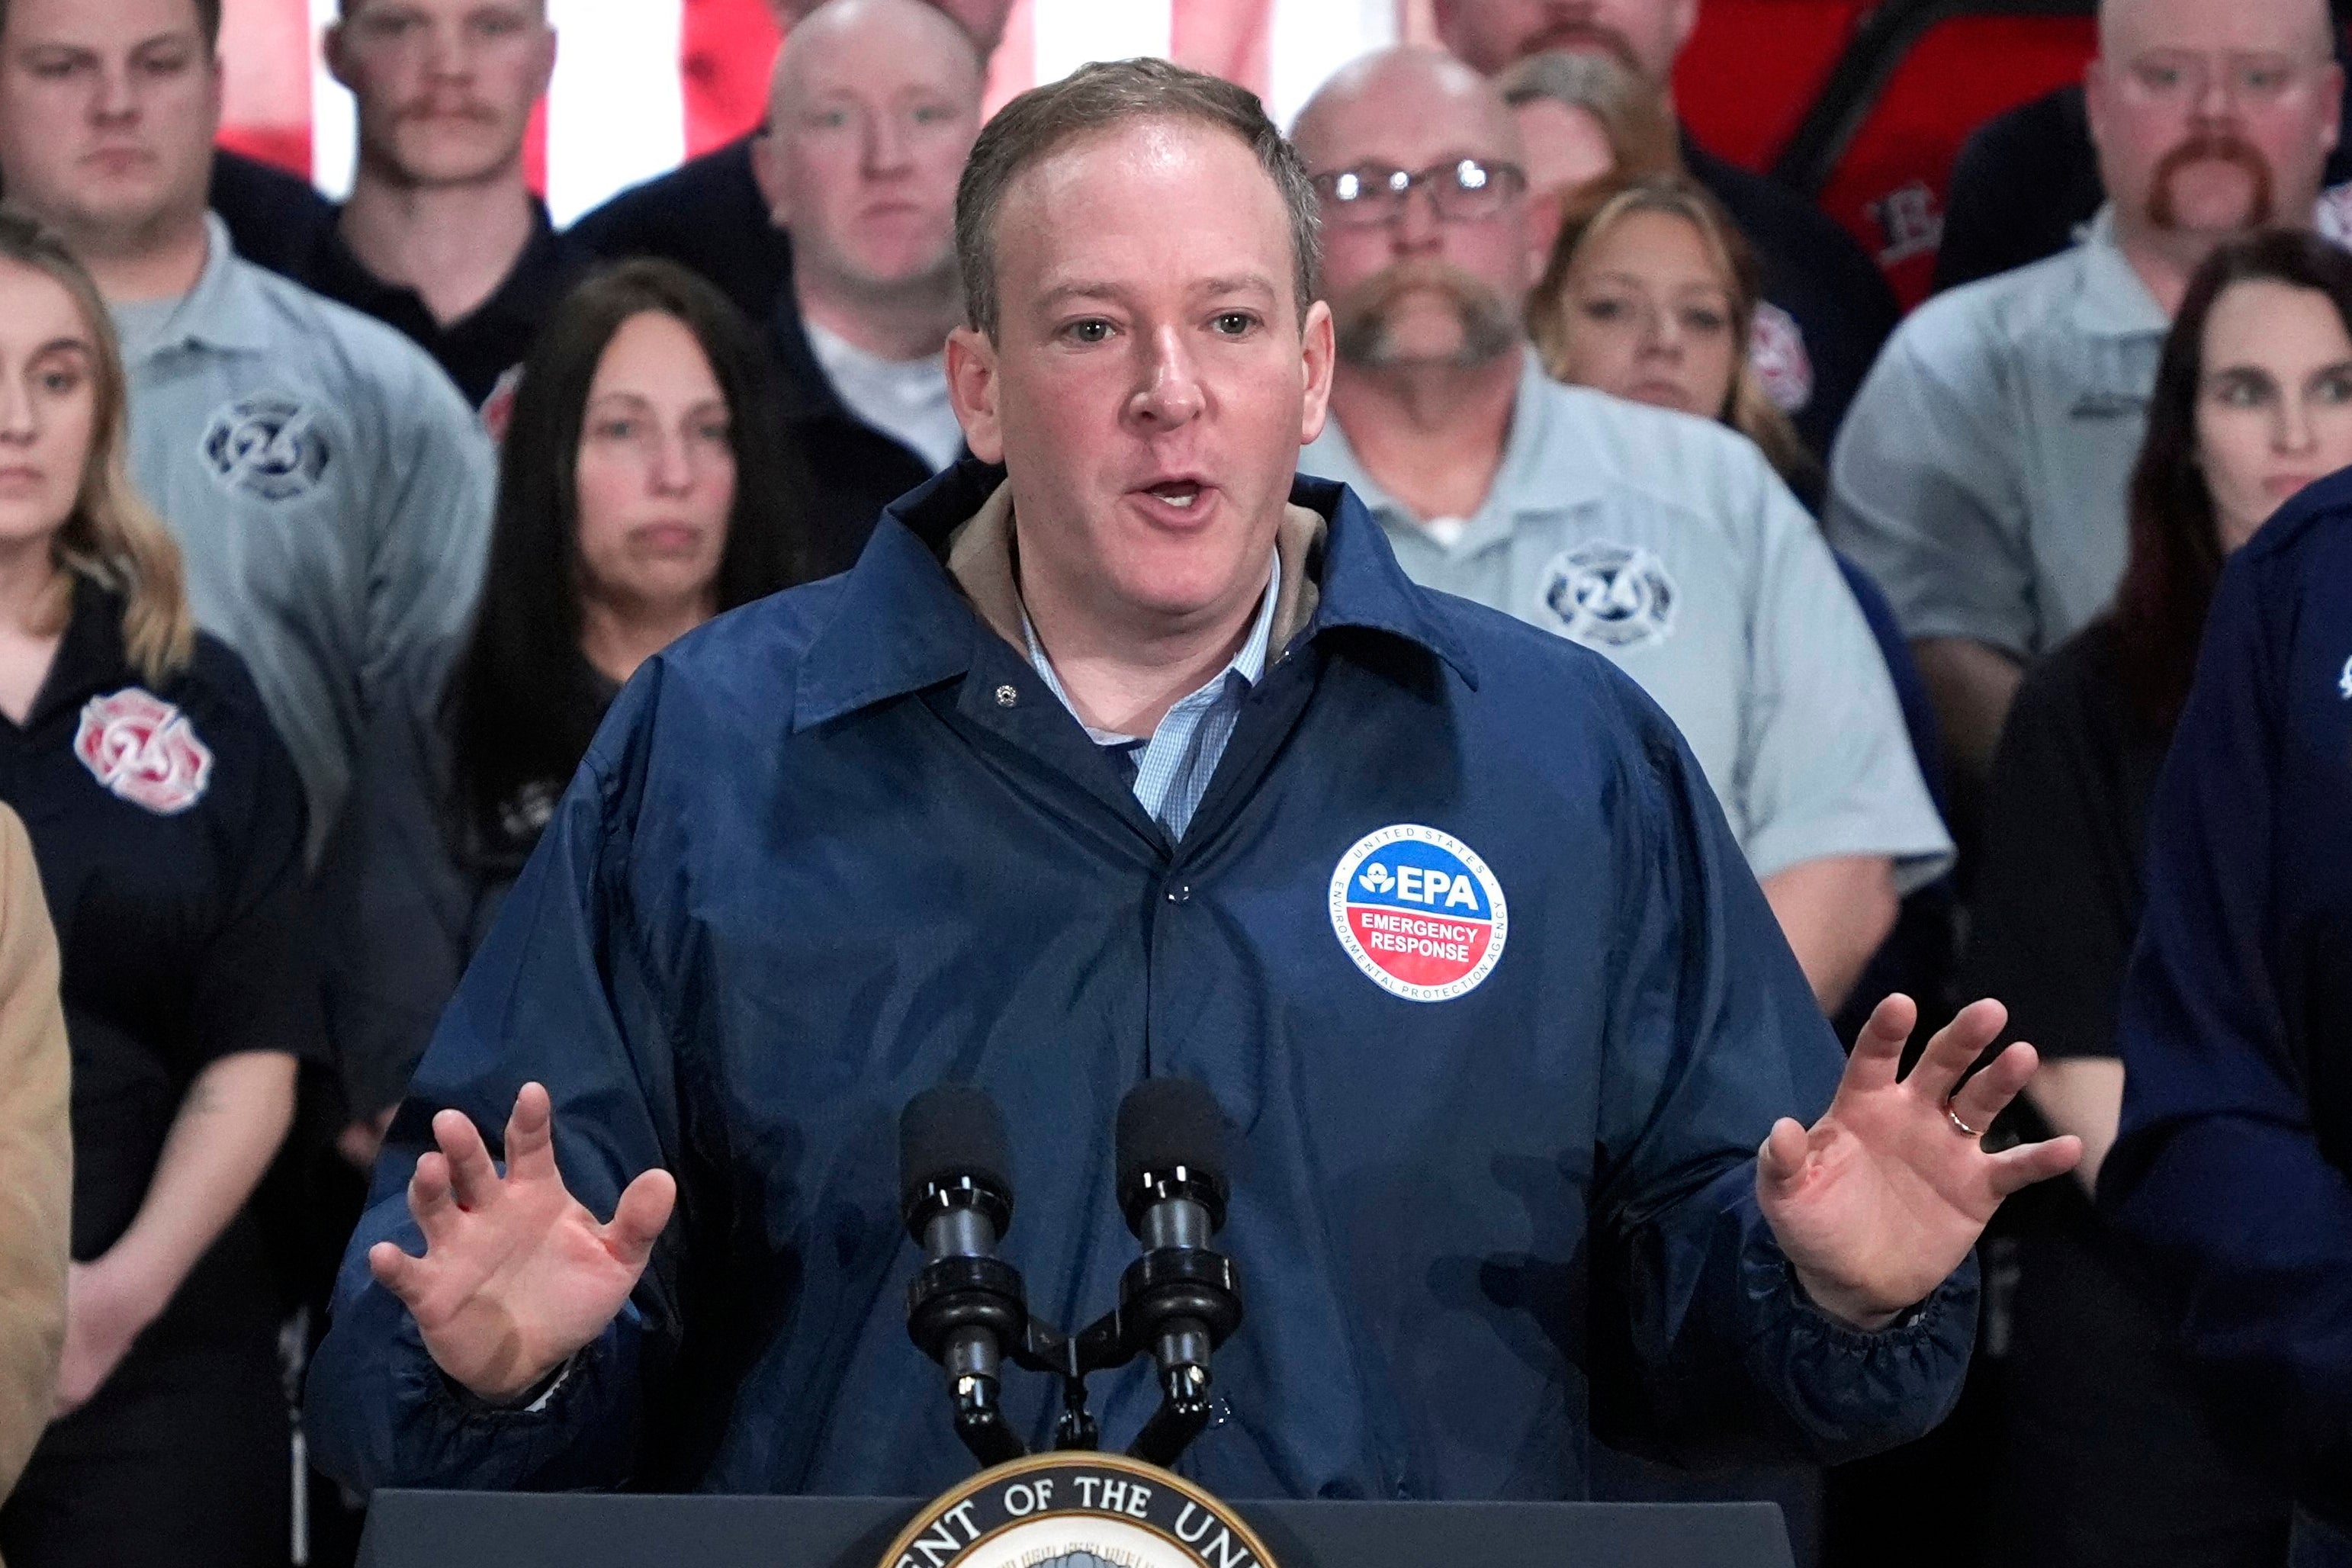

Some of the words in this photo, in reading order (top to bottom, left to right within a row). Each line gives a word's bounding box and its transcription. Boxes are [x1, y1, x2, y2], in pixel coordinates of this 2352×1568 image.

[1353, 827, 1415, 859] UNITED
[1425, 831, 1485, 874] STATES
[1397, 865, 1480, 911] EPA
[1333, 881, 1395, 989] ENVIRONMENTAL
[1402, 964, 1489, 999] PROTECTION
[1487, 901, 1505, 962] AGENCY
[1361, 913, 1478, 943] EMERGENCY
[1371, 931, 1470, 962] RESPONSE
[1004, 1478, 1054, 1516] OF
[1074, 1476, 1152, 1518] THE
[1174, 1501, 1262, 1568] UN
